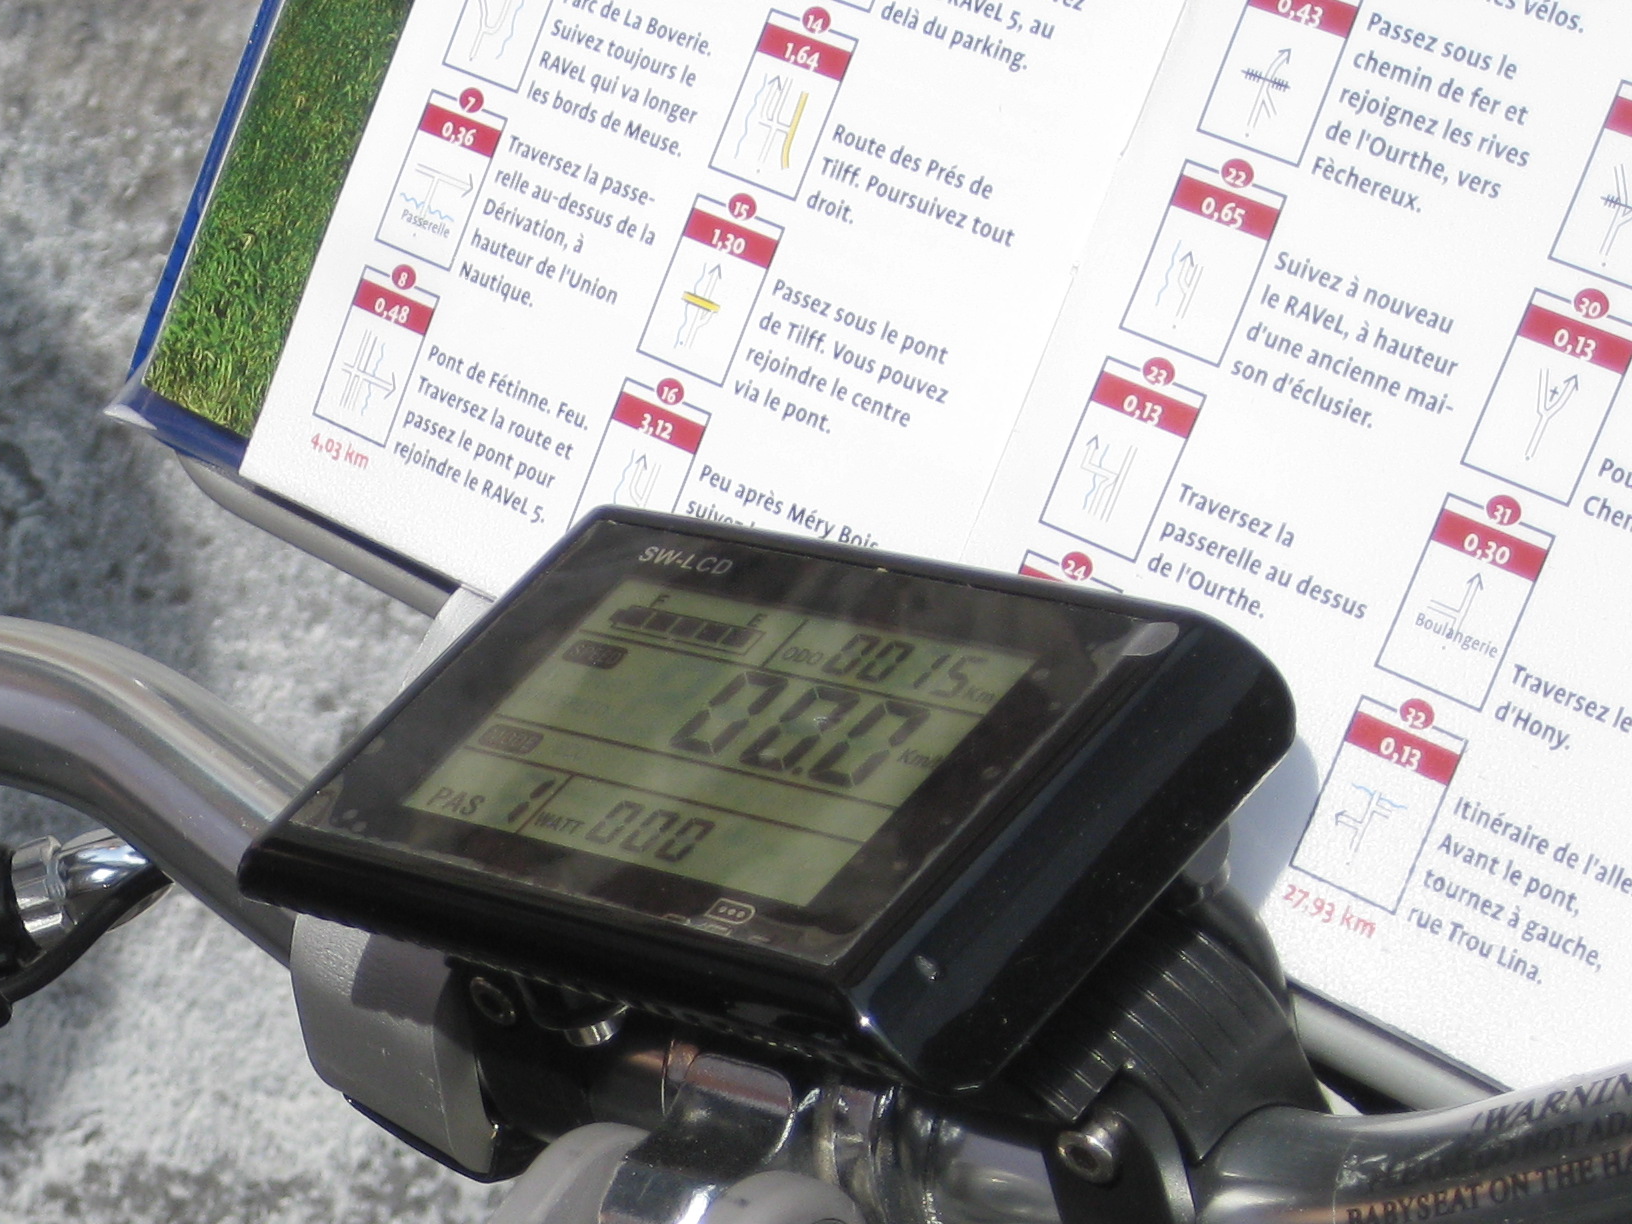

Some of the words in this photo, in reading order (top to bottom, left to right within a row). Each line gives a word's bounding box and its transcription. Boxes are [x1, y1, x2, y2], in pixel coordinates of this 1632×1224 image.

[600, 2, 620, 21] de
[623, 9, 642, 30] La
[646, 17, 710, 56] Boverie.
[803, 15, 823, 35] 14
[881, 2, 918, 29] delà
[923, 16, 947, 40] du
[949, 30, 1026, 72] parking.
[1007, 10, 1022, 31] 5,
[1030, 19, 1054, 39] au
[1367, 12, 1438, 52] Passez
[1441, 42, 1492, 70] sous
[1525, 2, 1583, 32] vélos.
[551, 19, 604, 52] Suivez
[607, 41, 677, 79] toujours
[785, 43, 819, 72] 1,64
[463, 97, 475, 113] 7
[539, 51, 585, 83] RAVeL
[591, 74, 619, 93] qui
[643, 88, 697, 123] longer
[1354, 50, 1432, 91] chemin
[1438, 78, 1464, 102] de
[1469, 87, 1501, 114] fer
[441, 122, 475, 148] 0,36
[527, 81, 549, 104] les
[552, 90, 597, 123] bords
[601, 111, 620, 132] de
[624, 120, 680, 156] Meuse.
[1339, 88, 1438, 135] rejoignez
[1442, 119, 1473, 146] les
[1477, 134, 1529, 166] rives
[509, 135, 581, 178] Traversez
[600, 176, 654, 205] passe-
[832, 124, 885, 158] Route
[890, 146, 921, 171] des
[926, 159, 965, 188] Prés
[969, 176, 992, 199] de
[1224, 168, 1246, 188] 22
[1312, 156, 1420, 212] Fèchereux.
[1326, 120, 1351, 145] de
[1356, 129, 1448, 184] l'Ourthe,
[1458, 170, 1501, 198] vers
[402, 209, 449, 237] Passerelle
[483, 198, 567, 250] Dérivation,
[495, 170, 529, 194] relle
[532, 185, 613, 227] au-dessus
[616, 216, 636, 237] de
[730, 202, 749, 221] 15
[807, 191, 852, 224] droit.
[822, 157, 861, 187] Tilff.
[866, 175, 967, 228] Poursuivez
[972, 217, 1014, 246] tout
[1202, 197, 1245, 230] 0,65
[471, 228, 533, 268] hauteur
[536, 257, 555, 278] de
[559, 264, 617, 304] l'Union
[711, 229, 745, 257] 1,30
[398, 272, 407, 286] 8
[459, 261, 532, 307] Nautique.
[1275, 252, 1342, 291] Suivez
[1363, 288, 1453, 333] nouveau
[374, 298, 409, 322] 0,48
[772, 279, 831, 316] Passez
[834, 308, 876, 335] sous
[900, 335, 948, 364] pont
[1284, 295, 1348, 339] RAVeL,
[1373, 328, 1458, 375] hauteur
[1576, 298, 1601, 320] 30
[759, 312, 781, 334] de
[787, 322, 826, 353] Tilff.
[834, 341, 875, 373] Vous
[877, 365, 948, 403] pouvez
[1246, 322, 1302, 358] d'une
[1307, 349, 1400, 396] ancienne
[1405, 387, 1452, 413] mai-
[1554, 329, 1595, 361] 0,13
[428, 345, 464, 374] Pont
[466, 362, 485, 384] de
[489, 372, 550, 413] Fétinne.
[556, 402, 587, 430] Feu.
[659, 387, 678, 405] 16
[746, 348, 826, 392] rejoindre
[852, 393, 910, 427] centre
[1145, 366, 1167, 387] 23
[1231, 360, 1268, 385] son
[1273, 373, 1371, 428] d'éclusier.
[418, 376, 488, 421] Traversez
[508, 421, 551, 450] route
[637, 414, 672, 439] 3,12
[735, 380, 759, 402] via
[782, 402, 830, 433] pont.
[1123, 395, 1162, 425] 0,13
[345, 444, 369, 466] km
[403, 410, 455, 443] passez
[473, 443, 513, 470] pont
[514, 461, 555, 487] pour
[394, 441, 461, 482] rejoindre
[481, 479, 528, 515] RAVeL
[699, 465, 731, 492] Peu
[735, 484, 783, 514] après
[787, 503, 835, 539] Méry
[1179, 483, 1272, 537] Traversez
[1490, 505, 1511, 526] 31
[639, 546, 733, 575] SW-LCD
[1063, 560, 1085, 580] 24
[1159, 522, 1261, 574] passerelle
[1265, 566, 1292, 587] au
[1296, 576, 1367, 618] dessus
[1464, 534, 1509, 564] 0,30
[1148, 553, 1172, 577] de
[1176, 563, 1263, 618] l'Ourthe.
[1416, 613, 1497, 657] Boulangerie
[1403, 708, 1425, 730] 32
[1513, 664, 1610, 722] Traversez
[1495, 701, 1569, 750] d'Hony.
[1380, 737, 1421, 769] 0,13
[428, 787, 485, 816] PAS
[585, 801, 716, 862] 000
[1454, 797, 1549, 854] Itinéraire
[1553, 843, 1578, 868] de
[1438, 834, 1499, 874] Avant
[1524, 877, 1578, 916] pont,
[1339, 912, 1376, 939] km
[1408, 908, 1442, 934] rue
[1448, 921, 1493, 958] Trou
[1497, 946, 1541, 984] Lina.
[1424, 870, 1504, 920] tournez
[1522, 920, 1600, 971] gauche,
